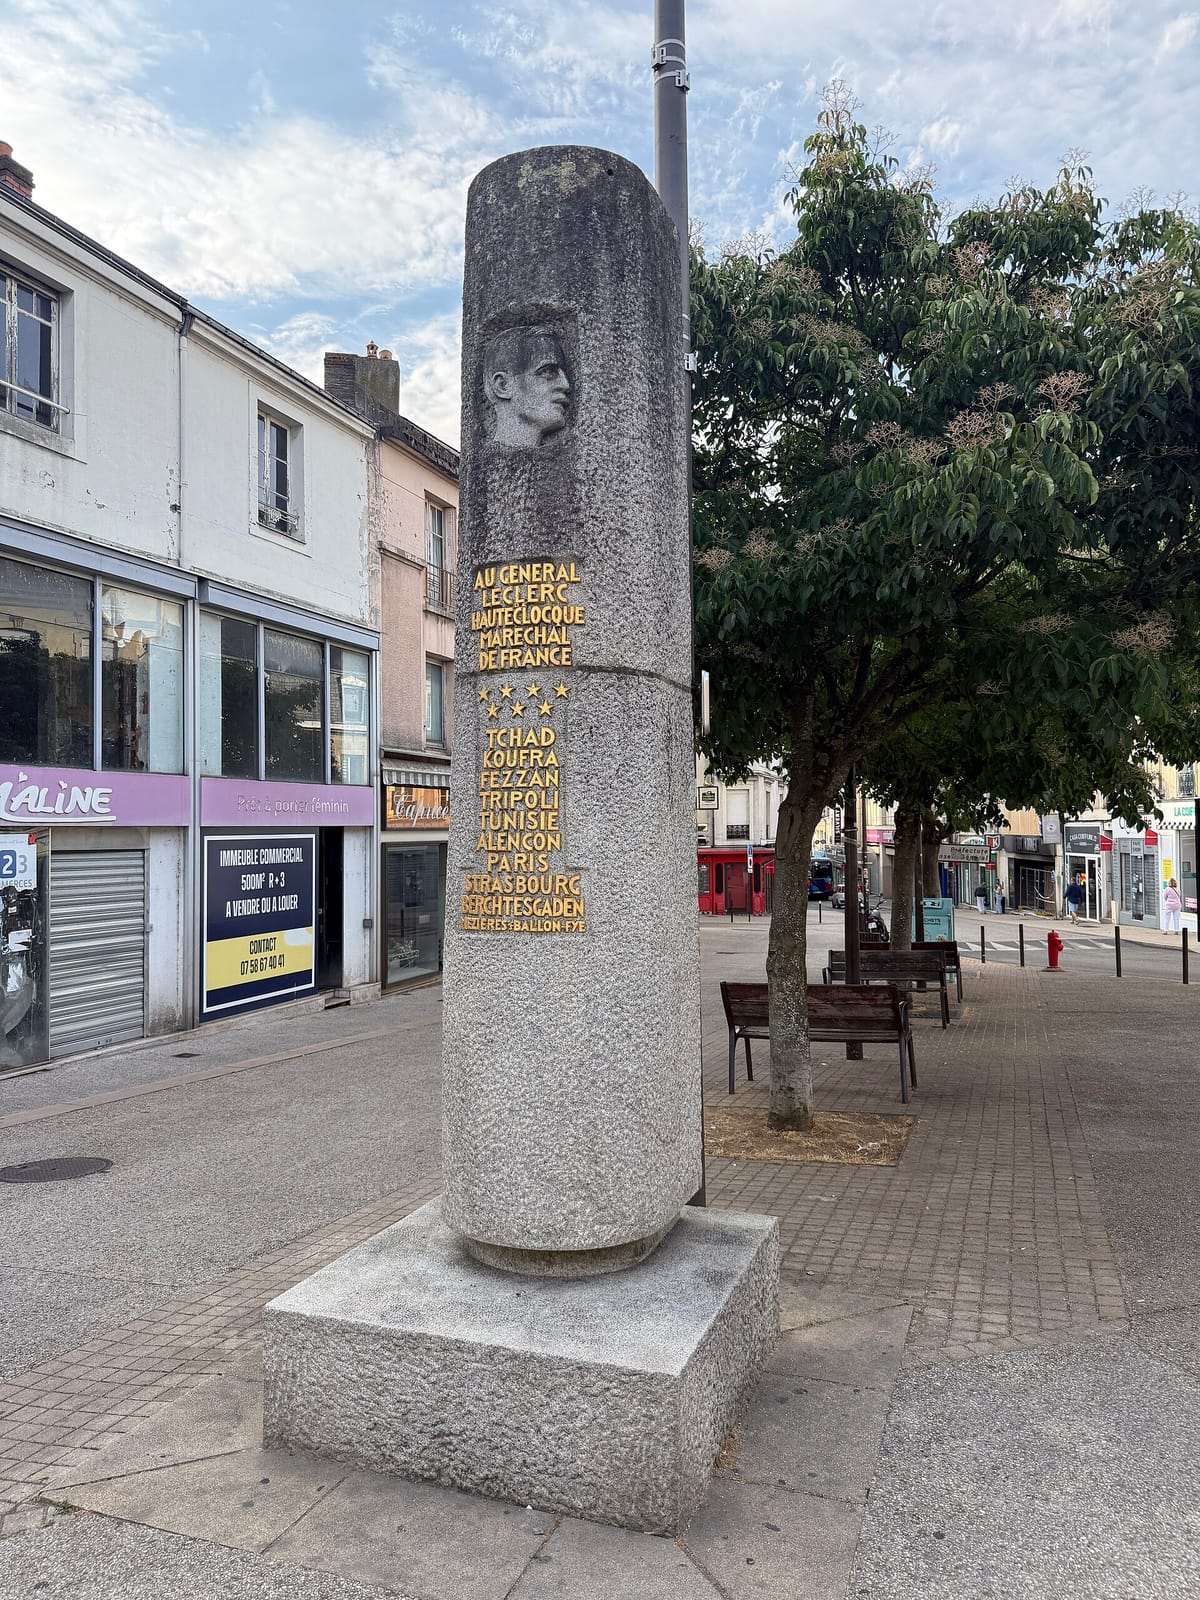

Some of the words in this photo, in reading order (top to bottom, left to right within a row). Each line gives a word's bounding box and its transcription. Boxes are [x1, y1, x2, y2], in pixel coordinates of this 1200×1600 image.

[474, 568, 496, 591] AU
[500, 563, 581, 584] GENERAL
[482, 583, 568, 608] LECLERC
[471, 606, 585, 630] HAUTECLOCQUE
[480, 627, 570, 649] MARECHAL
[479, 652, 498, 671] DE
[501, 648, 572, 669] FRANCE
[486, 728, 556, 748] TCHAD
[483, 750, 559, 768] KOUFRA
[480, 770, 559, 789] FEZZAN
[274, 799, 309, 816] porter
[311, 798, 349, 813] féminin
[479, 791, 559, 810] TRIPOLI
[478, 811, 559, 831] TUNISIE
[220, 849, 259, 867] IMMEUBLE
[259, 847, 304, 865] COMMERCIAL
[487, 853, 549, 872] PARIS
[465, 874, 581, 895] STRASBOURG
[225, 901, 231, 918] A
[232, 897, 260, 917] VENDRE
[261, 896, 271, 914] OU
[271, 896, 278, 912] A
[278, 894, 298, 911] LOUER
[461, 895, 584, 917] BERCHTESGADEN
[249, 937, 277, 955] CONTACT
[240, 961, 249, 976] 07
[250, 959, 259, 974] 58
[259, 957, 267, 972] 67
[268, 955, 277, 970] 40
[278, 953, 285, 968] 41
